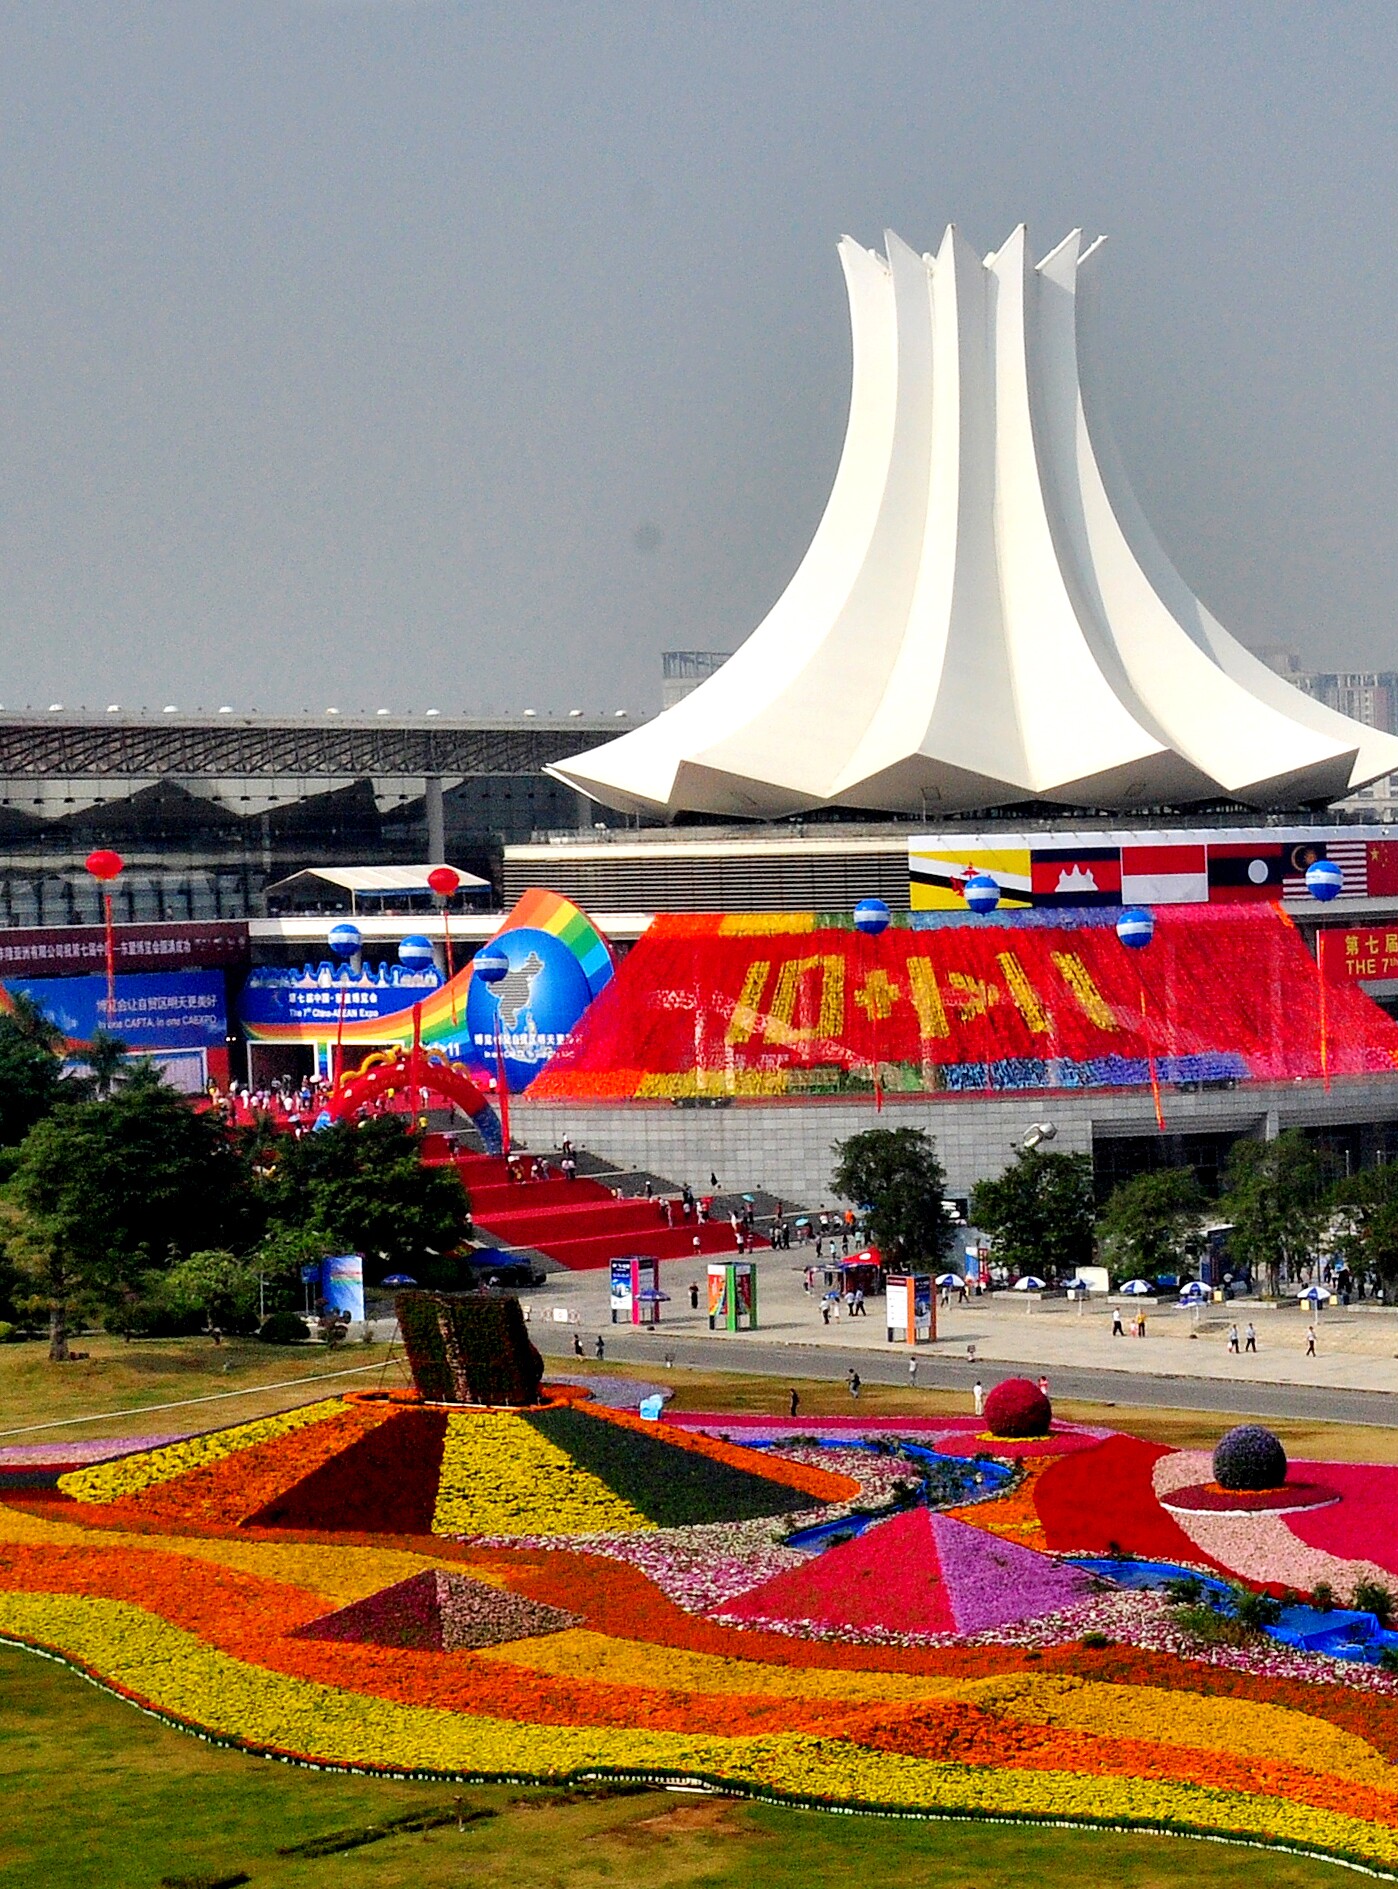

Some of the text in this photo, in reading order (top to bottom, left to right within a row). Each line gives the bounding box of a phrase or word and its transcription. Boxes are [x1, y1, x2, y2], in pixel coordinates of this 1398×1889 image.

[1346, 959, 1377, 976] THE
[1382, 957, 1398, 974] 7th
[289, 1008, 303, 1017] The
[312, 1007, 358, 1018] China-AEAN
[359, 1008, 379, 1019] Expo
